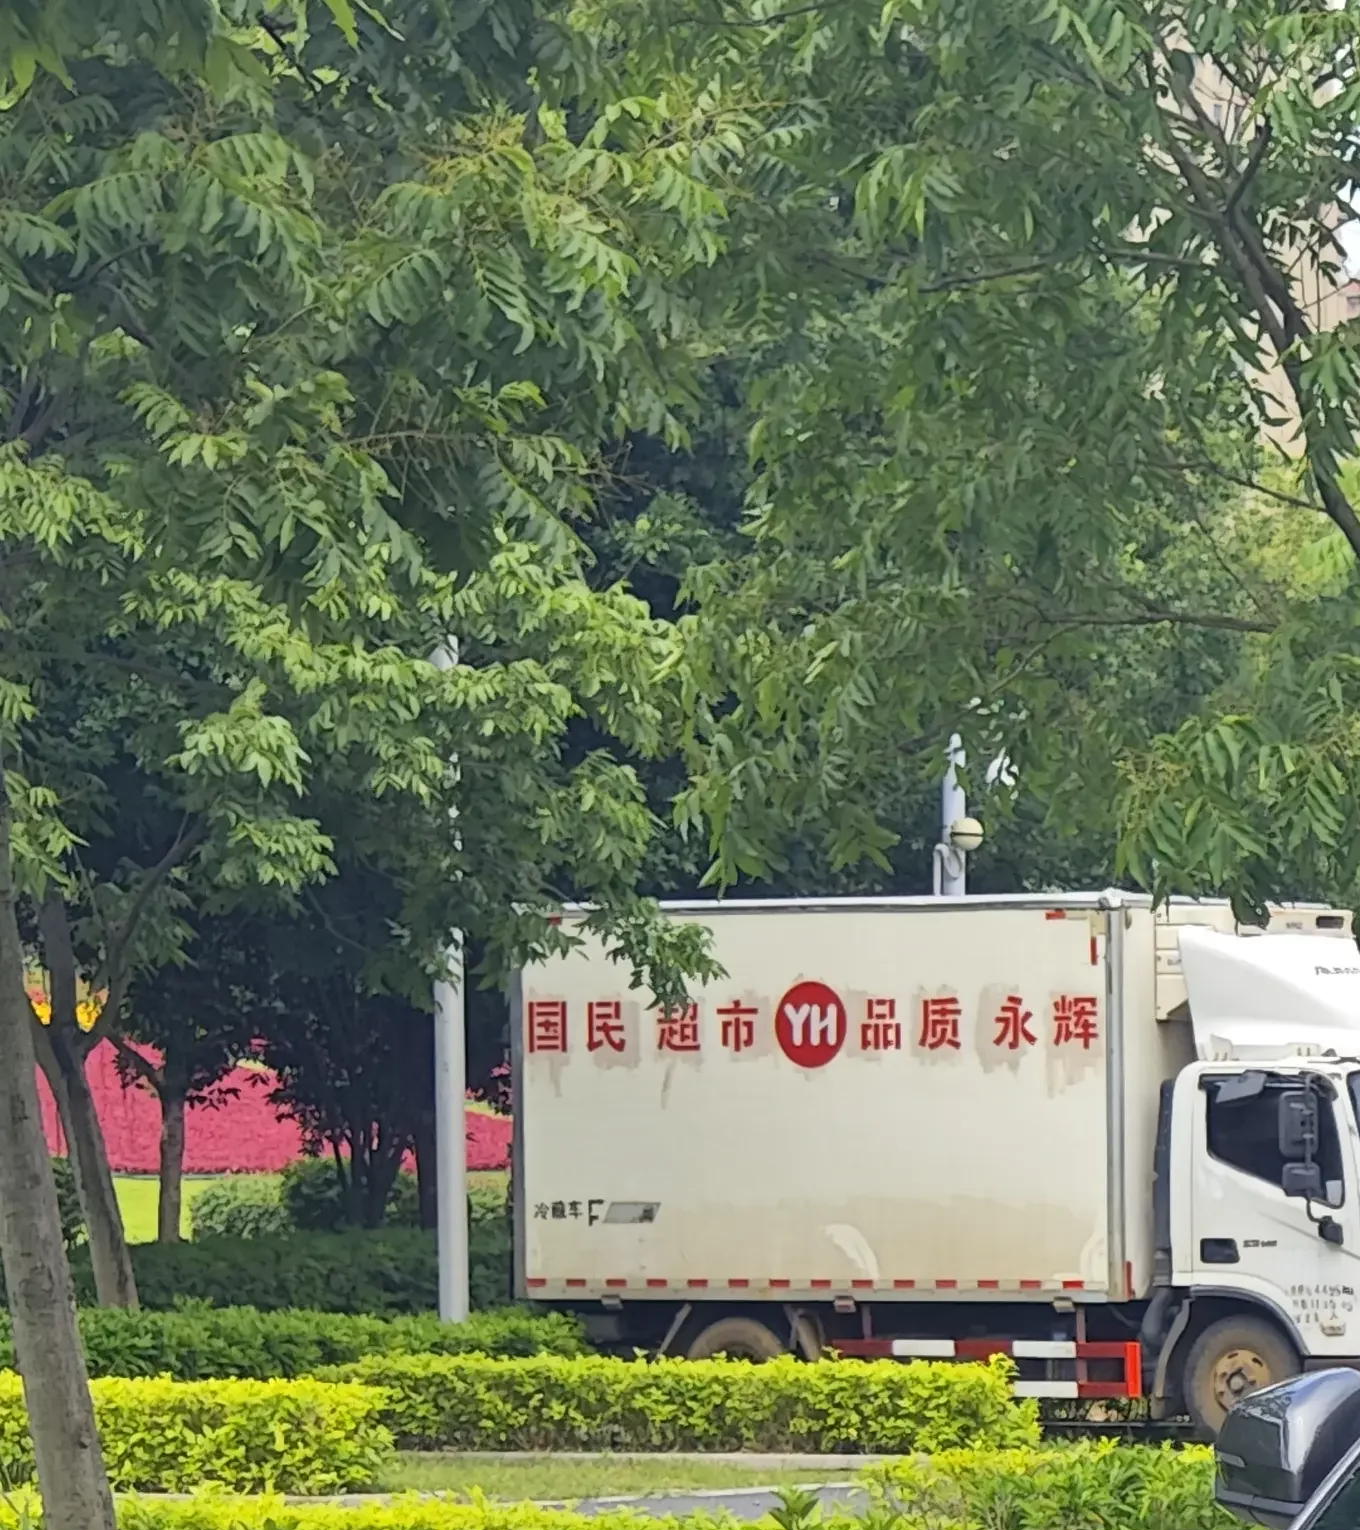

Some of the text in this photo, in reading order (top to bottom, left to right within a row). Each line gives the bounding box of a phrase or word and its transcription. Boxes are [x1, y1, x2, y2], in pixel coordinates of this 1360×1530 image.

[528, 995, 1099, 1052] 国民超市 YH 品质永辉
